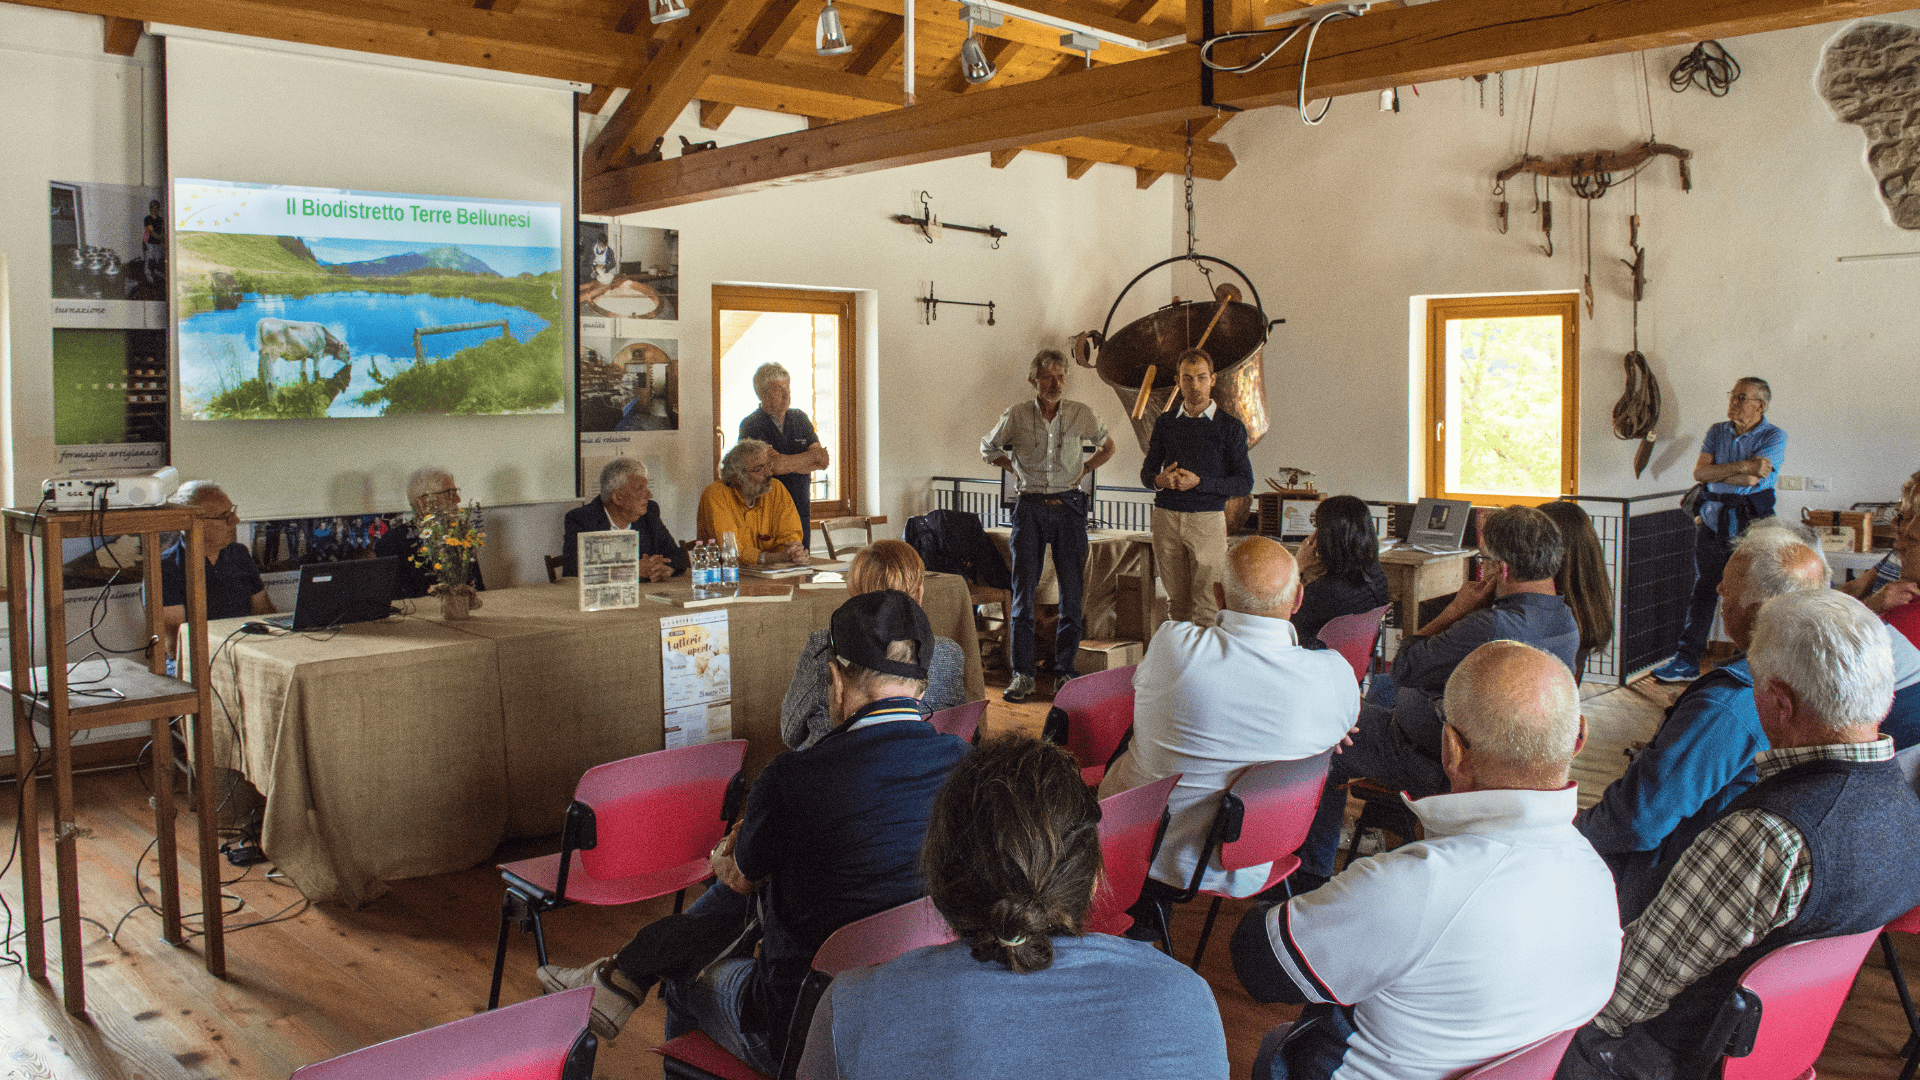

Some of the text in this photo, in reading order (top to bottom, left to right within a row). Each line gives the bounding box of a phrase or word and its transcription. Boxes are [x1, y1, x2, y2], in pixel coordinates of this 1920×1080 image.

[286, 197, 532, 228] Il Biodistretto Terre Bellunesi
[55, 306, 105, 314] turnazione
[60, 448, 159, 463] formaggio artigianale
[668, 633, 701, 653] Latterie
[687, 641, 712, 658] aperte
